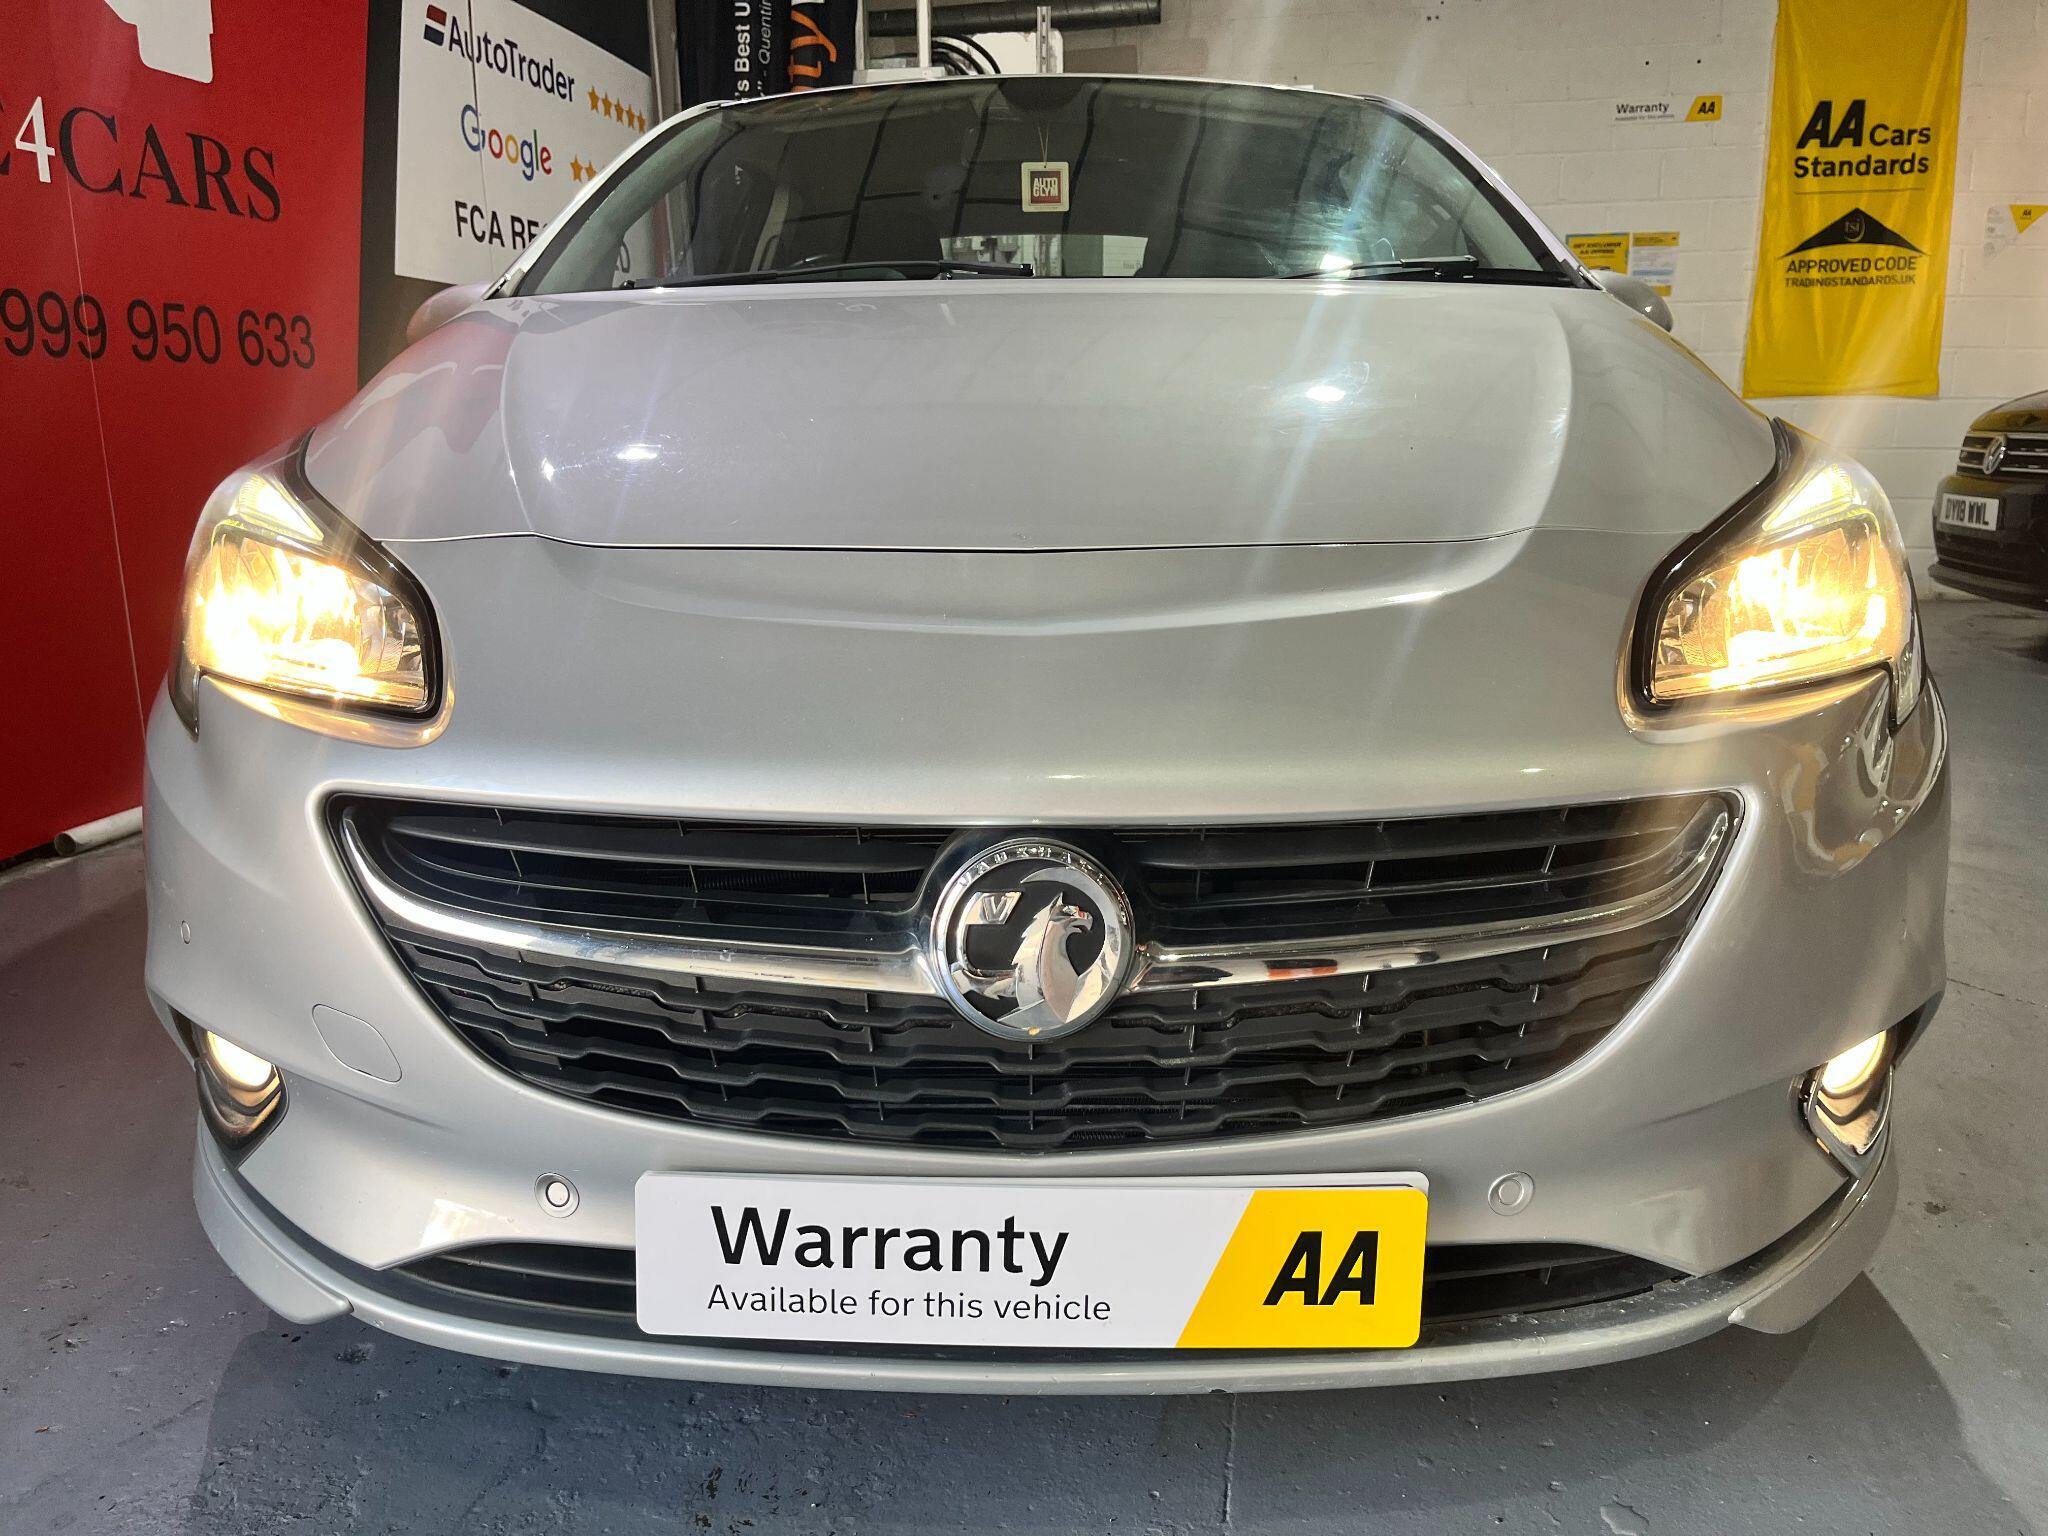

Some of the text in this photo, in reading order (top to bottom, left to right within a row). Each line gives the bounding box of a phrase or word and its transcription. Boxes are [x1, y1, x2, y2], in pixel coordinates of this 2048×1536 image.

[449, 16, 575, 102] AutoTrader
[734, 24, 751, 72] Best
[1616, 101, 1670, 114] Warranty
[1697, 101, 1716, 115] AA
[1796, 99, 1931, 149] AA Cars
[461, 104, 552, 181] Google
[1794, 152, 1930, 178] Standards
[1033, 177, 1058, 188] AUTO
[1033, 187, 1058, 197] GLYM
[455, 200, 548, 250] FCA RE
[1786, 255, 1918, 273] APPROVED CODE
[127, 299, 221, 365] 950
[237, 309, 316, 369] 633
[711, 1206, 1069, 1287] Warranty
[1262, 1231, 1379, 1305] AA
[707, 1284, 1111, 1321] Available for this vehicle
